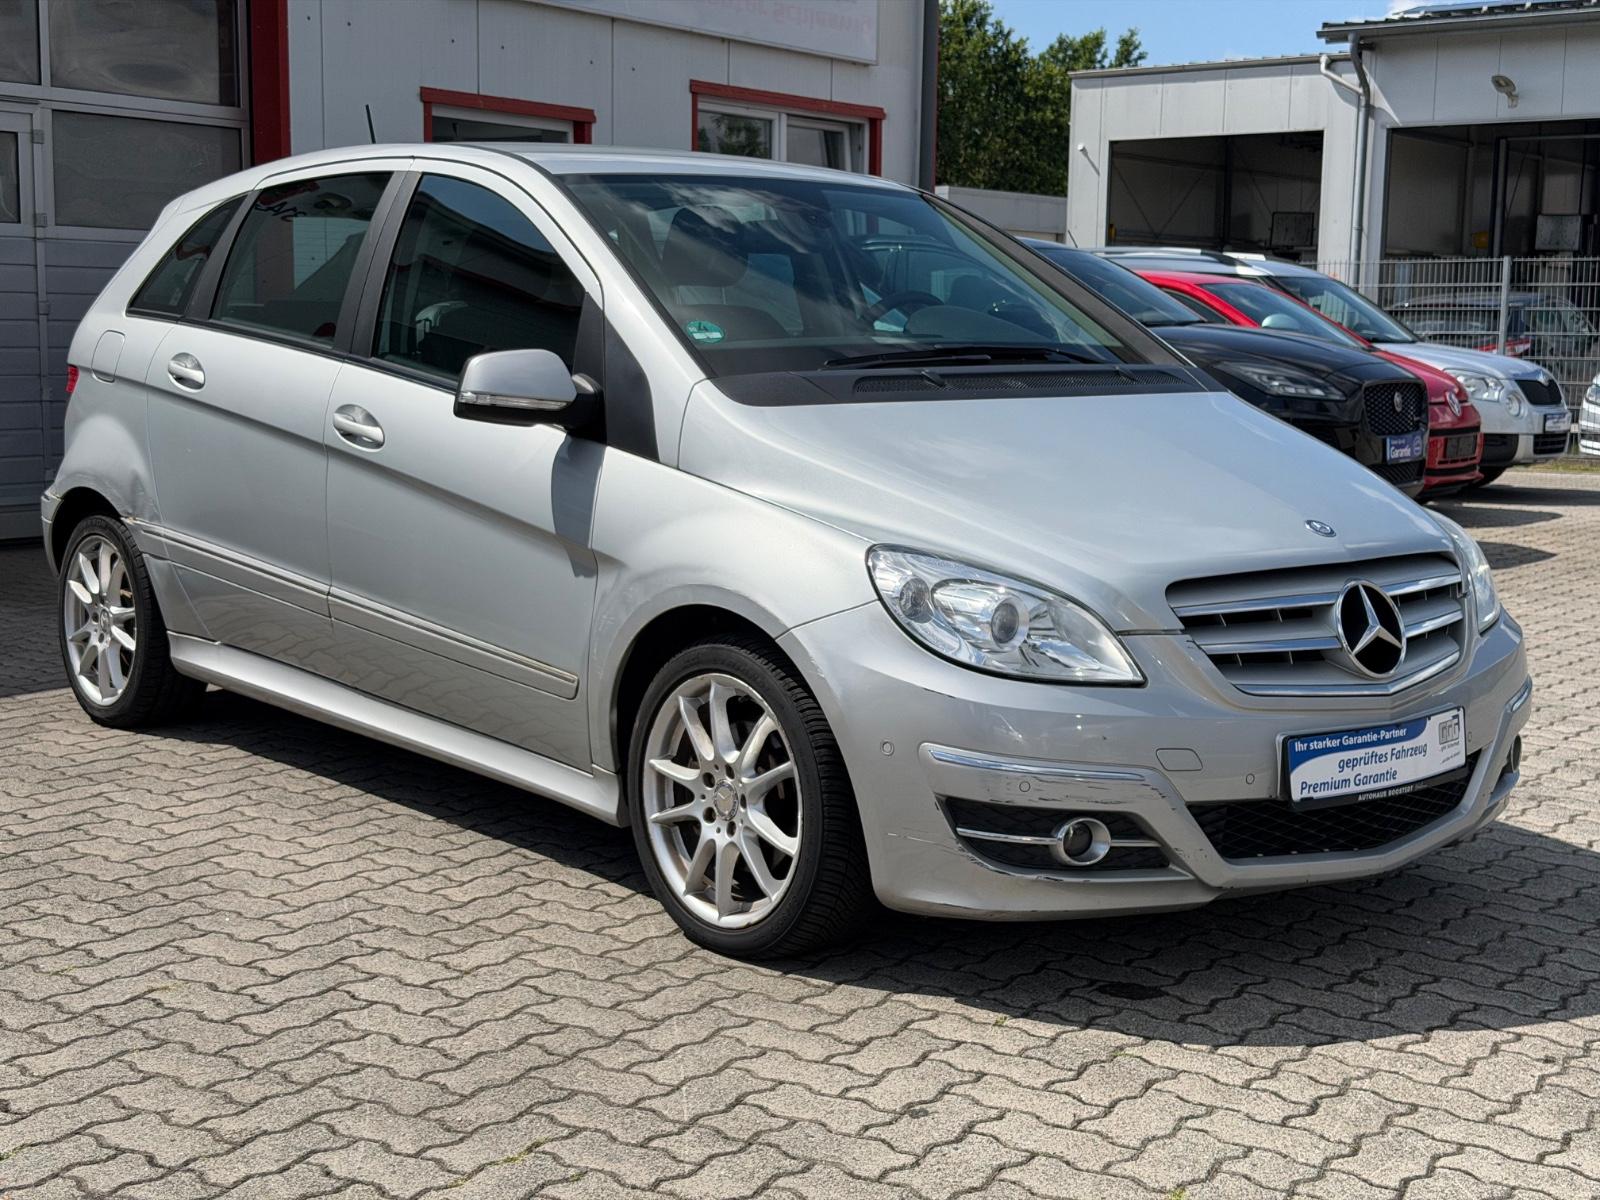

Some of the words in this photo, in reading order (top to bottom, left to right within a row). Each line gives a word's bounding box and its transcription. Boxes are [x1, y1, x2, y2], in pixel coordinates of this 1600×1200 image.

[1294, 741, 1308, 752] Ihr
[1309, 737, 1341, 750] starker
[1341, 728, 1407, 746] Garantie-Partner
[1337, 750, 1388, 774] geprüftes
[1389, 743, 1428, 762] Fahrzeug
[1300, 776, 1351, 796] Premium
[1353, 767, 1398, 787] Garantie
[1357, 791, 1387, 801] AUTOHAUS
